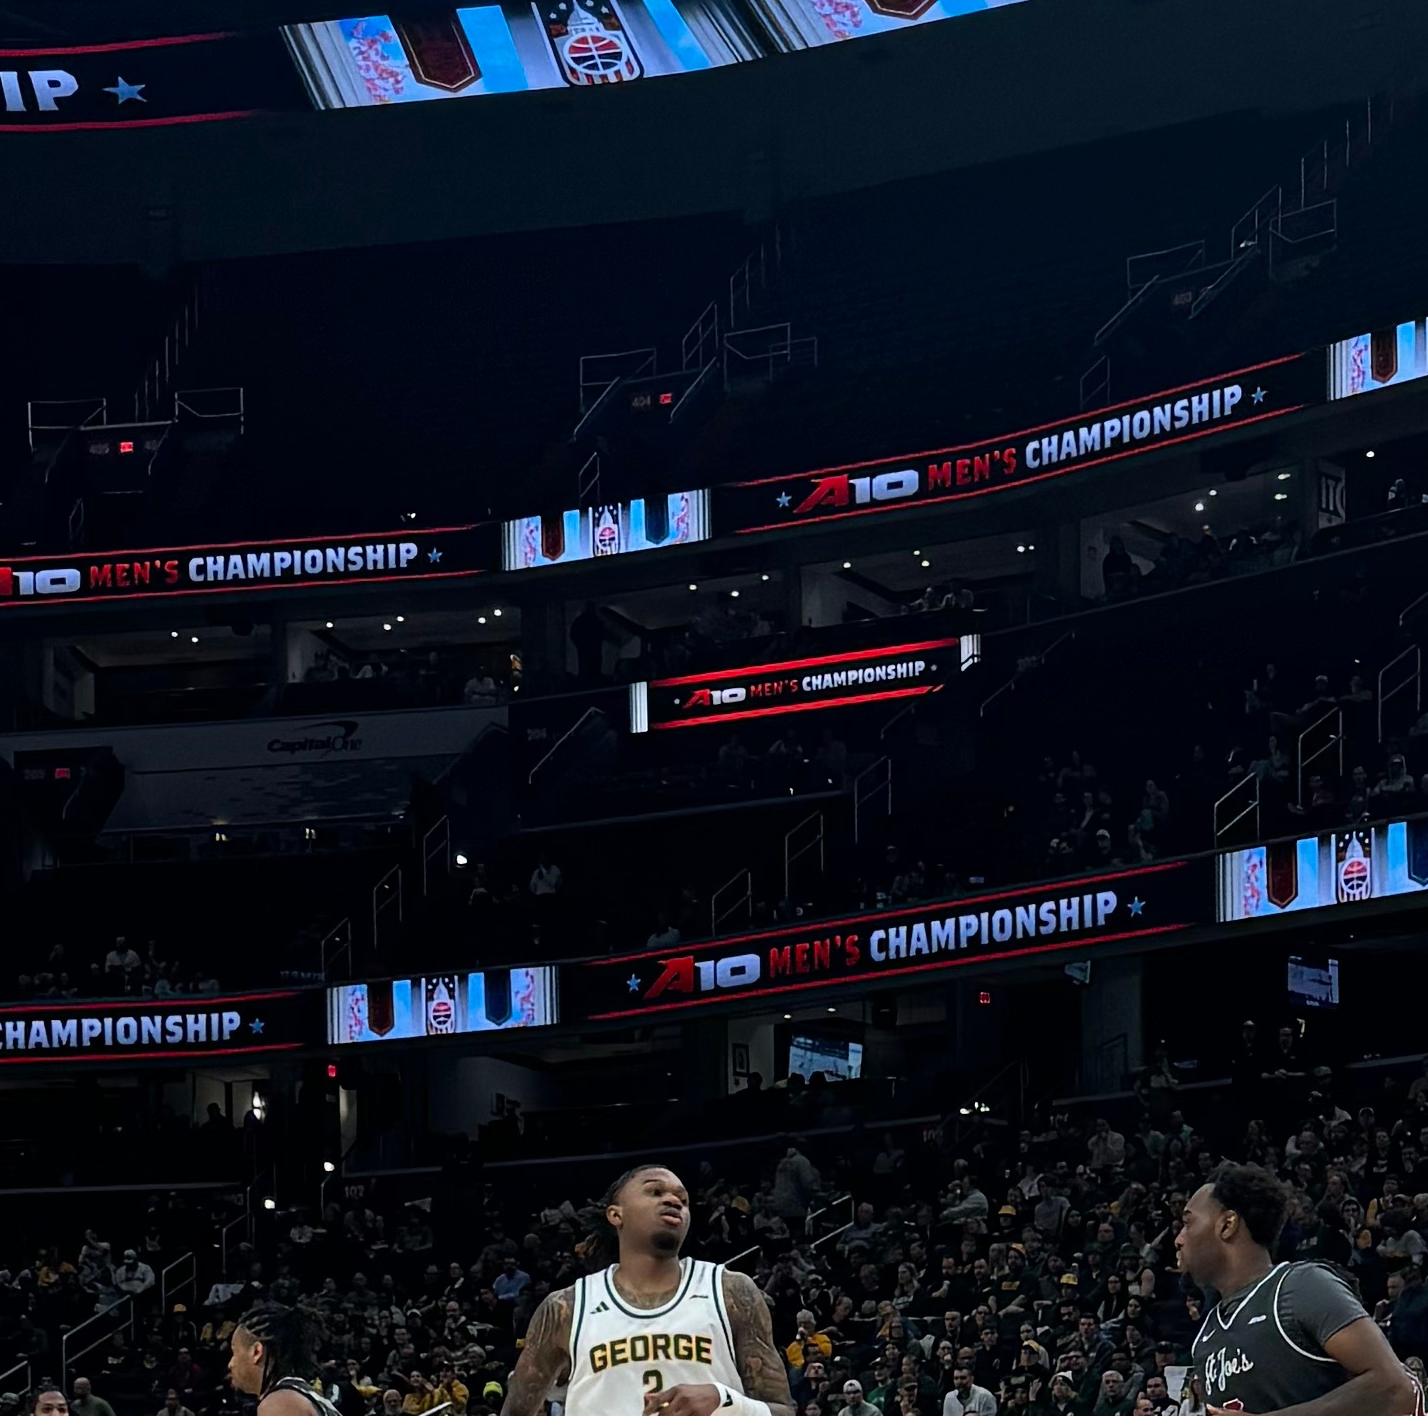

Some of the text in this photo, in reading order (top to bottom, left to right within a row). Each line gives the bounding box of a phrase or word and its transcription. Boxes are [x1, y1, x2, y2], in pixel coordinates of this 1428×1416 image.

[794, 384, 1243, 514] A10 MEN'S CHAMPIONSHIP
[89, 560, 179, 588] MEN'S
[188, 541, 418, 583] CHAMPIONSHIP
[682, 660, 926, 709] A10 MEN'S CHAMPIONSHIP
[644, 891, 1118, 999] A10 MEN'S CHAMPIONSHIP
[589, 1333, 712, 1374] GEORGE
[642, 1369, 663, 1394] 2
